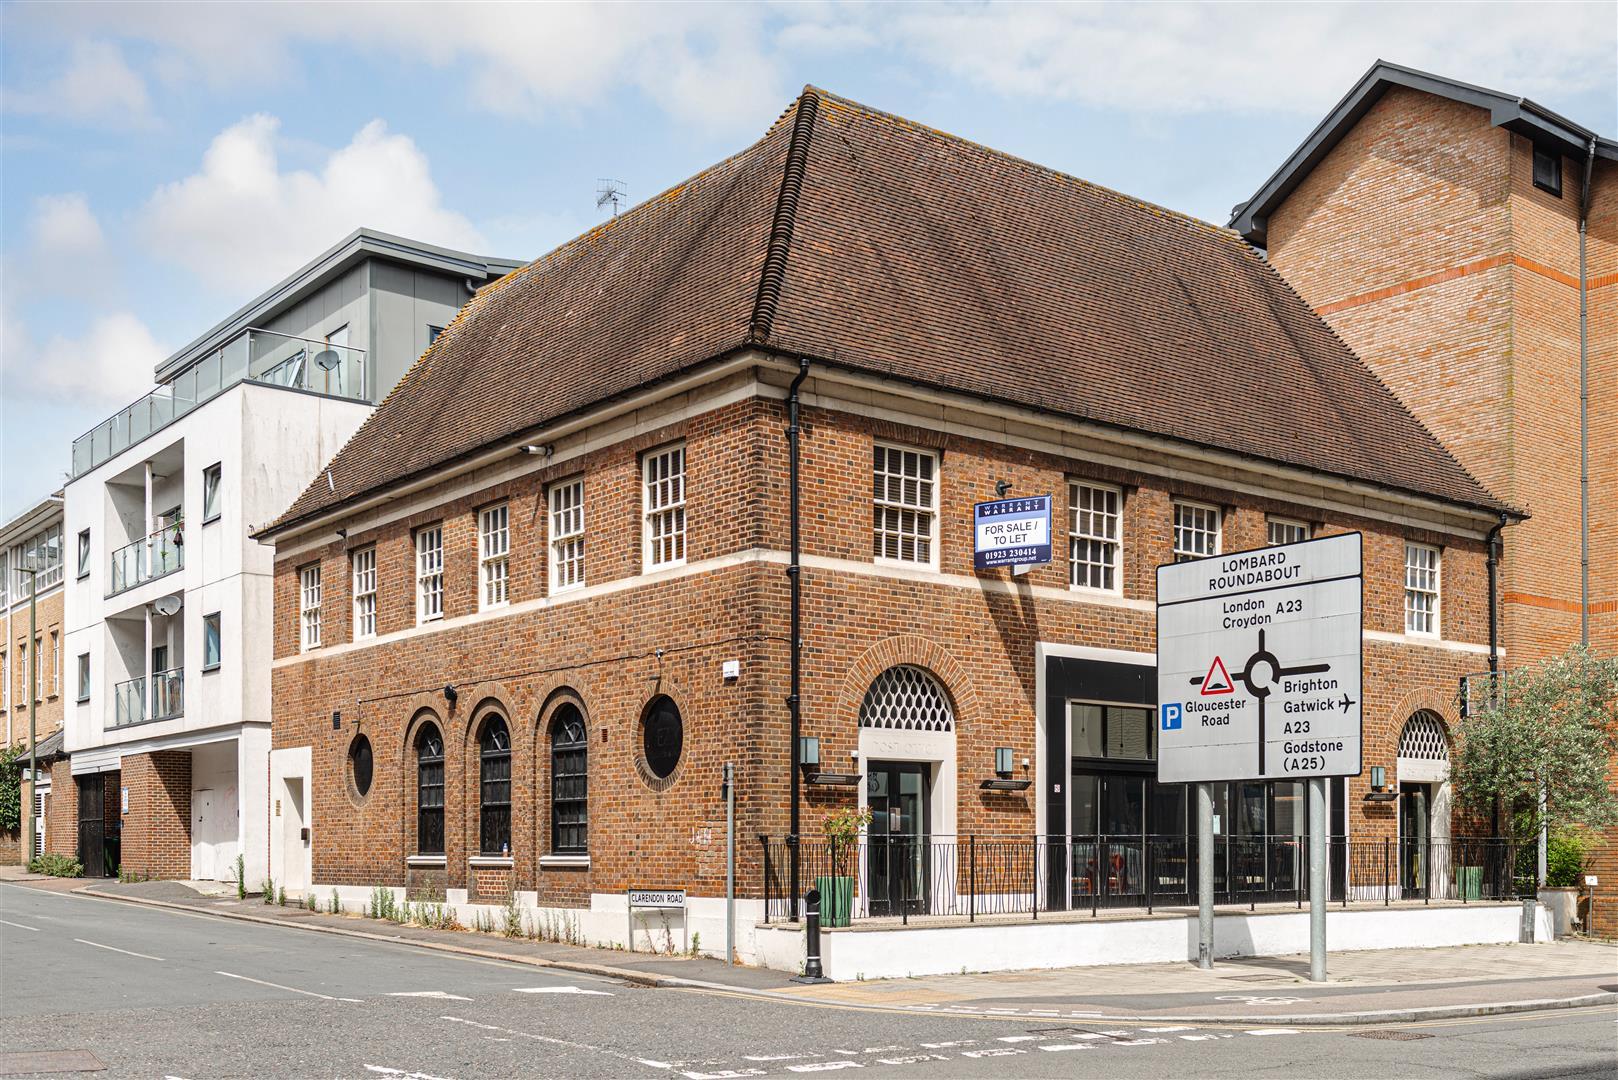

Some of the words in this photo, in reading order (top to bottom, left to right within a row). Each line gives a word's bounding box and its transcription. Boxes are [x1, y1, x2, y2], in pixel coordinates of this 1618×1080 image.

[984, 500, 1039, 510] WARRANT
[984, 504, 1039, 516] WARRANT
[985, 524, 1004, 535] FOR
[1006, 521, 1032, 533] SALE
[994, 536, 1007, 545] TO
[1009, 534, 1028, 544] LET
[985, 550, 1007, 560] 01923
[1009, 548, 1037, 557] 230414
[1222, 552, 1286, 573] LOMBARD
[1209, 565, 1301, 590] ROUNDABOUT
[1223, 599, 1265, 614] London
[1275, 600, 1303, 614] A23
[1222, 614, 1272, 630] Croydon
[1284, 679, 1338, 695] Brighton
[1185, 699, 1247, 713] Gloucester
[1283, 699, 1335, 713] Gatwick
[1166, 706, 1179, 727] P
[1201, 713, 1230, 726] Road
[1283, 721, 1311, 734] A23
[1283, 741, 1344, 754] Godstone
[1283, 756, 1326, 772] (A25)
[631, 894, 665, 903] CLARENDON
[667, 895, 683, 903] ROAD
